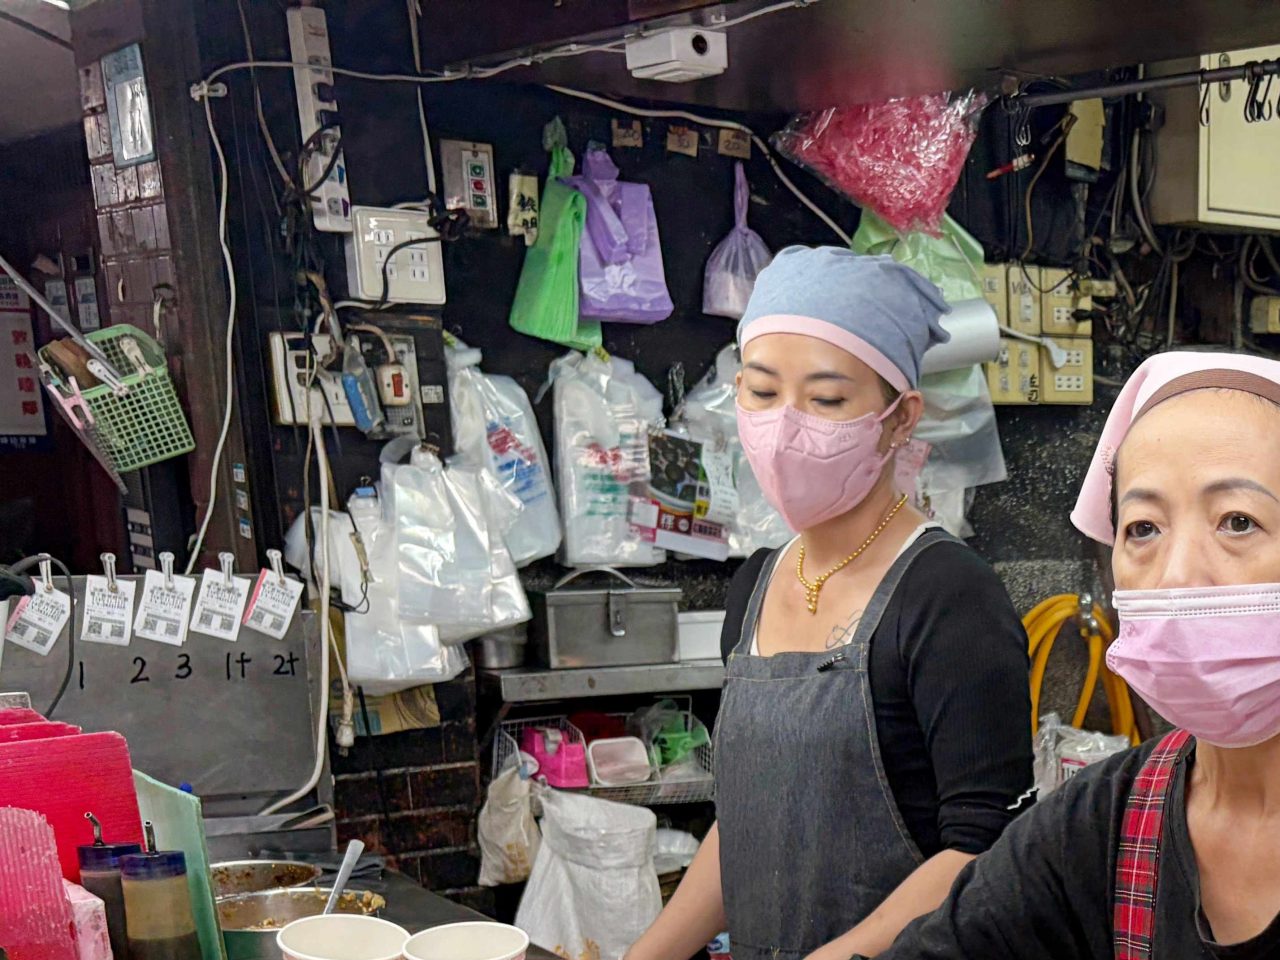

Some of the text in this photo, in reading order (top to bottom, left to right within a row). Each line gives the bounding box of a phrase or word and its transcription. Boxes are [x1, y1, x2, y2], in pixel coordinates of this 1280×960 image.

[78, 661, 85, 690] 1
[130, 656, 150, 684] 2
[174, 653, 193, 679] 3
